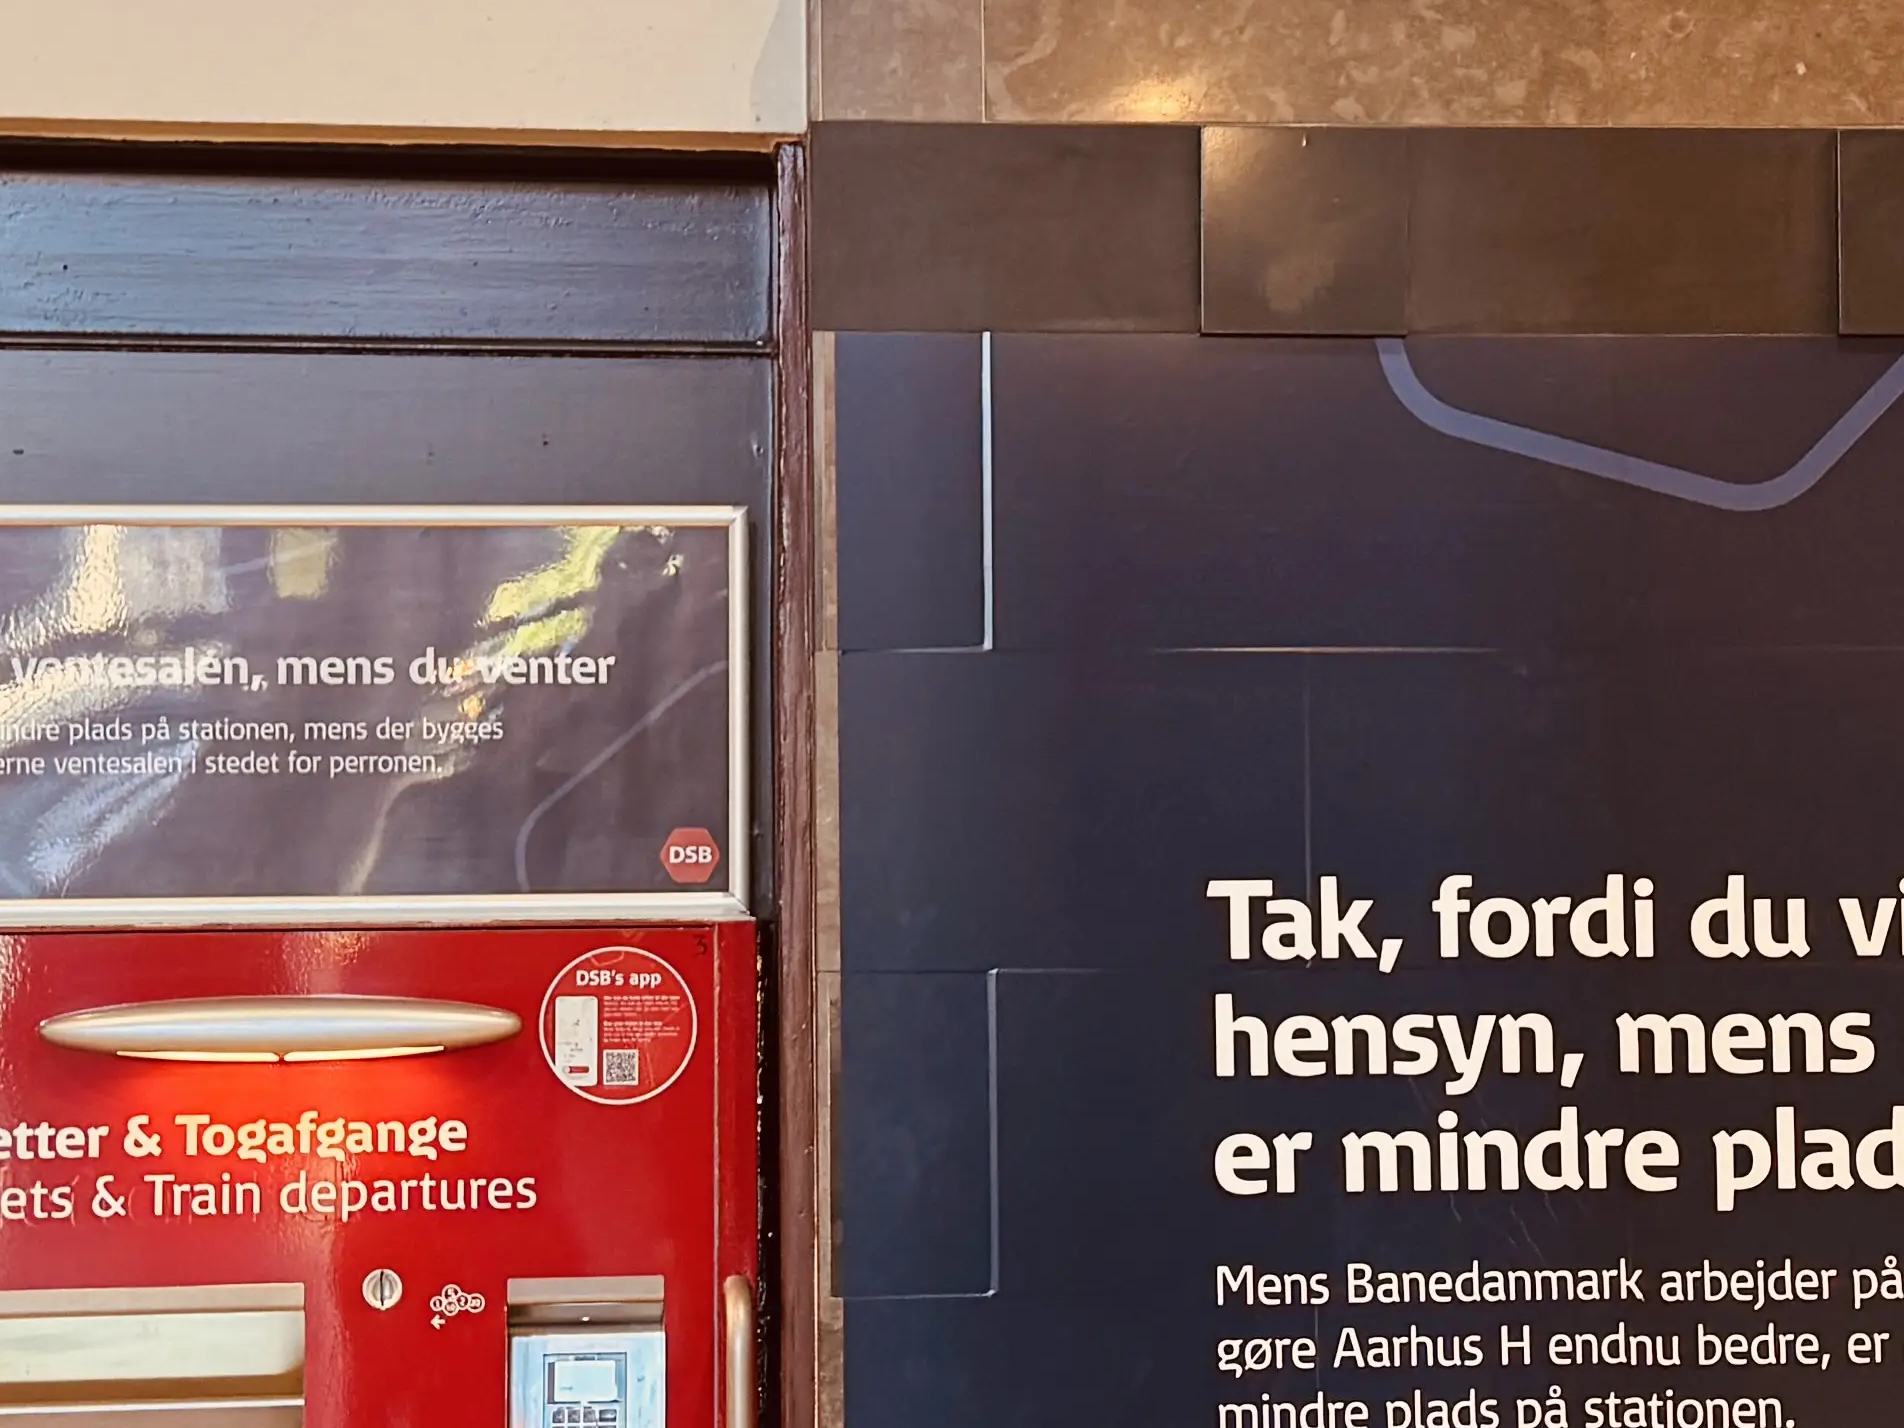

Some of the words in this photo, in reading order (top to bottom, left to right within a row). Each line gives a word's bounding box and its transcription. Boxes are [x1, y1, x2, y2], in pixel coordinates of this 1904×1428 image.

[277, 657, 394, 684] mens
[477, 646, 615, 684] venter
[69, 717, 133, 746] plads
[141, 714, 172, 746] på
[178, 716, 296, 744] stationen,
[668, 842, 712, 866] DSB
[1207, 876, 1403, 973] Tak,
[1432, 874, 1653, 958] fordi
[1691, 875, 1810, 958] du
[575, 969, 625, 986] DSB's
[628, 972, 663, 989] app
[1216, 994, 1584, 1095] hensyn,
[1616, 1013, 1874, 1074] mens
[124, 1115, 161, 1157] &
[175, 1113, 468, 1163] Togafgange
[1215, 1132, 1312, 1194] er
[1342, 1107, 1679, 1192] mindre
[92, 1175, 126, 1217] &
[146, 1174, 261, 1216] Train
[280, 1165, 536, 1222] departures
[1217, 1265, 1329, 1305] Mens
[1348, 1258, 1644, 1303] Banedanmark
[1661, 1259, 1837, 1310] arbejder
[1853, 1256, 1904, 1309] på
[1218, 1338, 1316, 1378] gøre
[1334, 1325, 1483, 1368] Aarhus
[1501, 1325, 1530, 1365] H
[1549, 1322, 1680, 1365] endnu
[1698, 1323, 1830, 1370] bedre,
[1848, 1333, 1889, 1363] er
